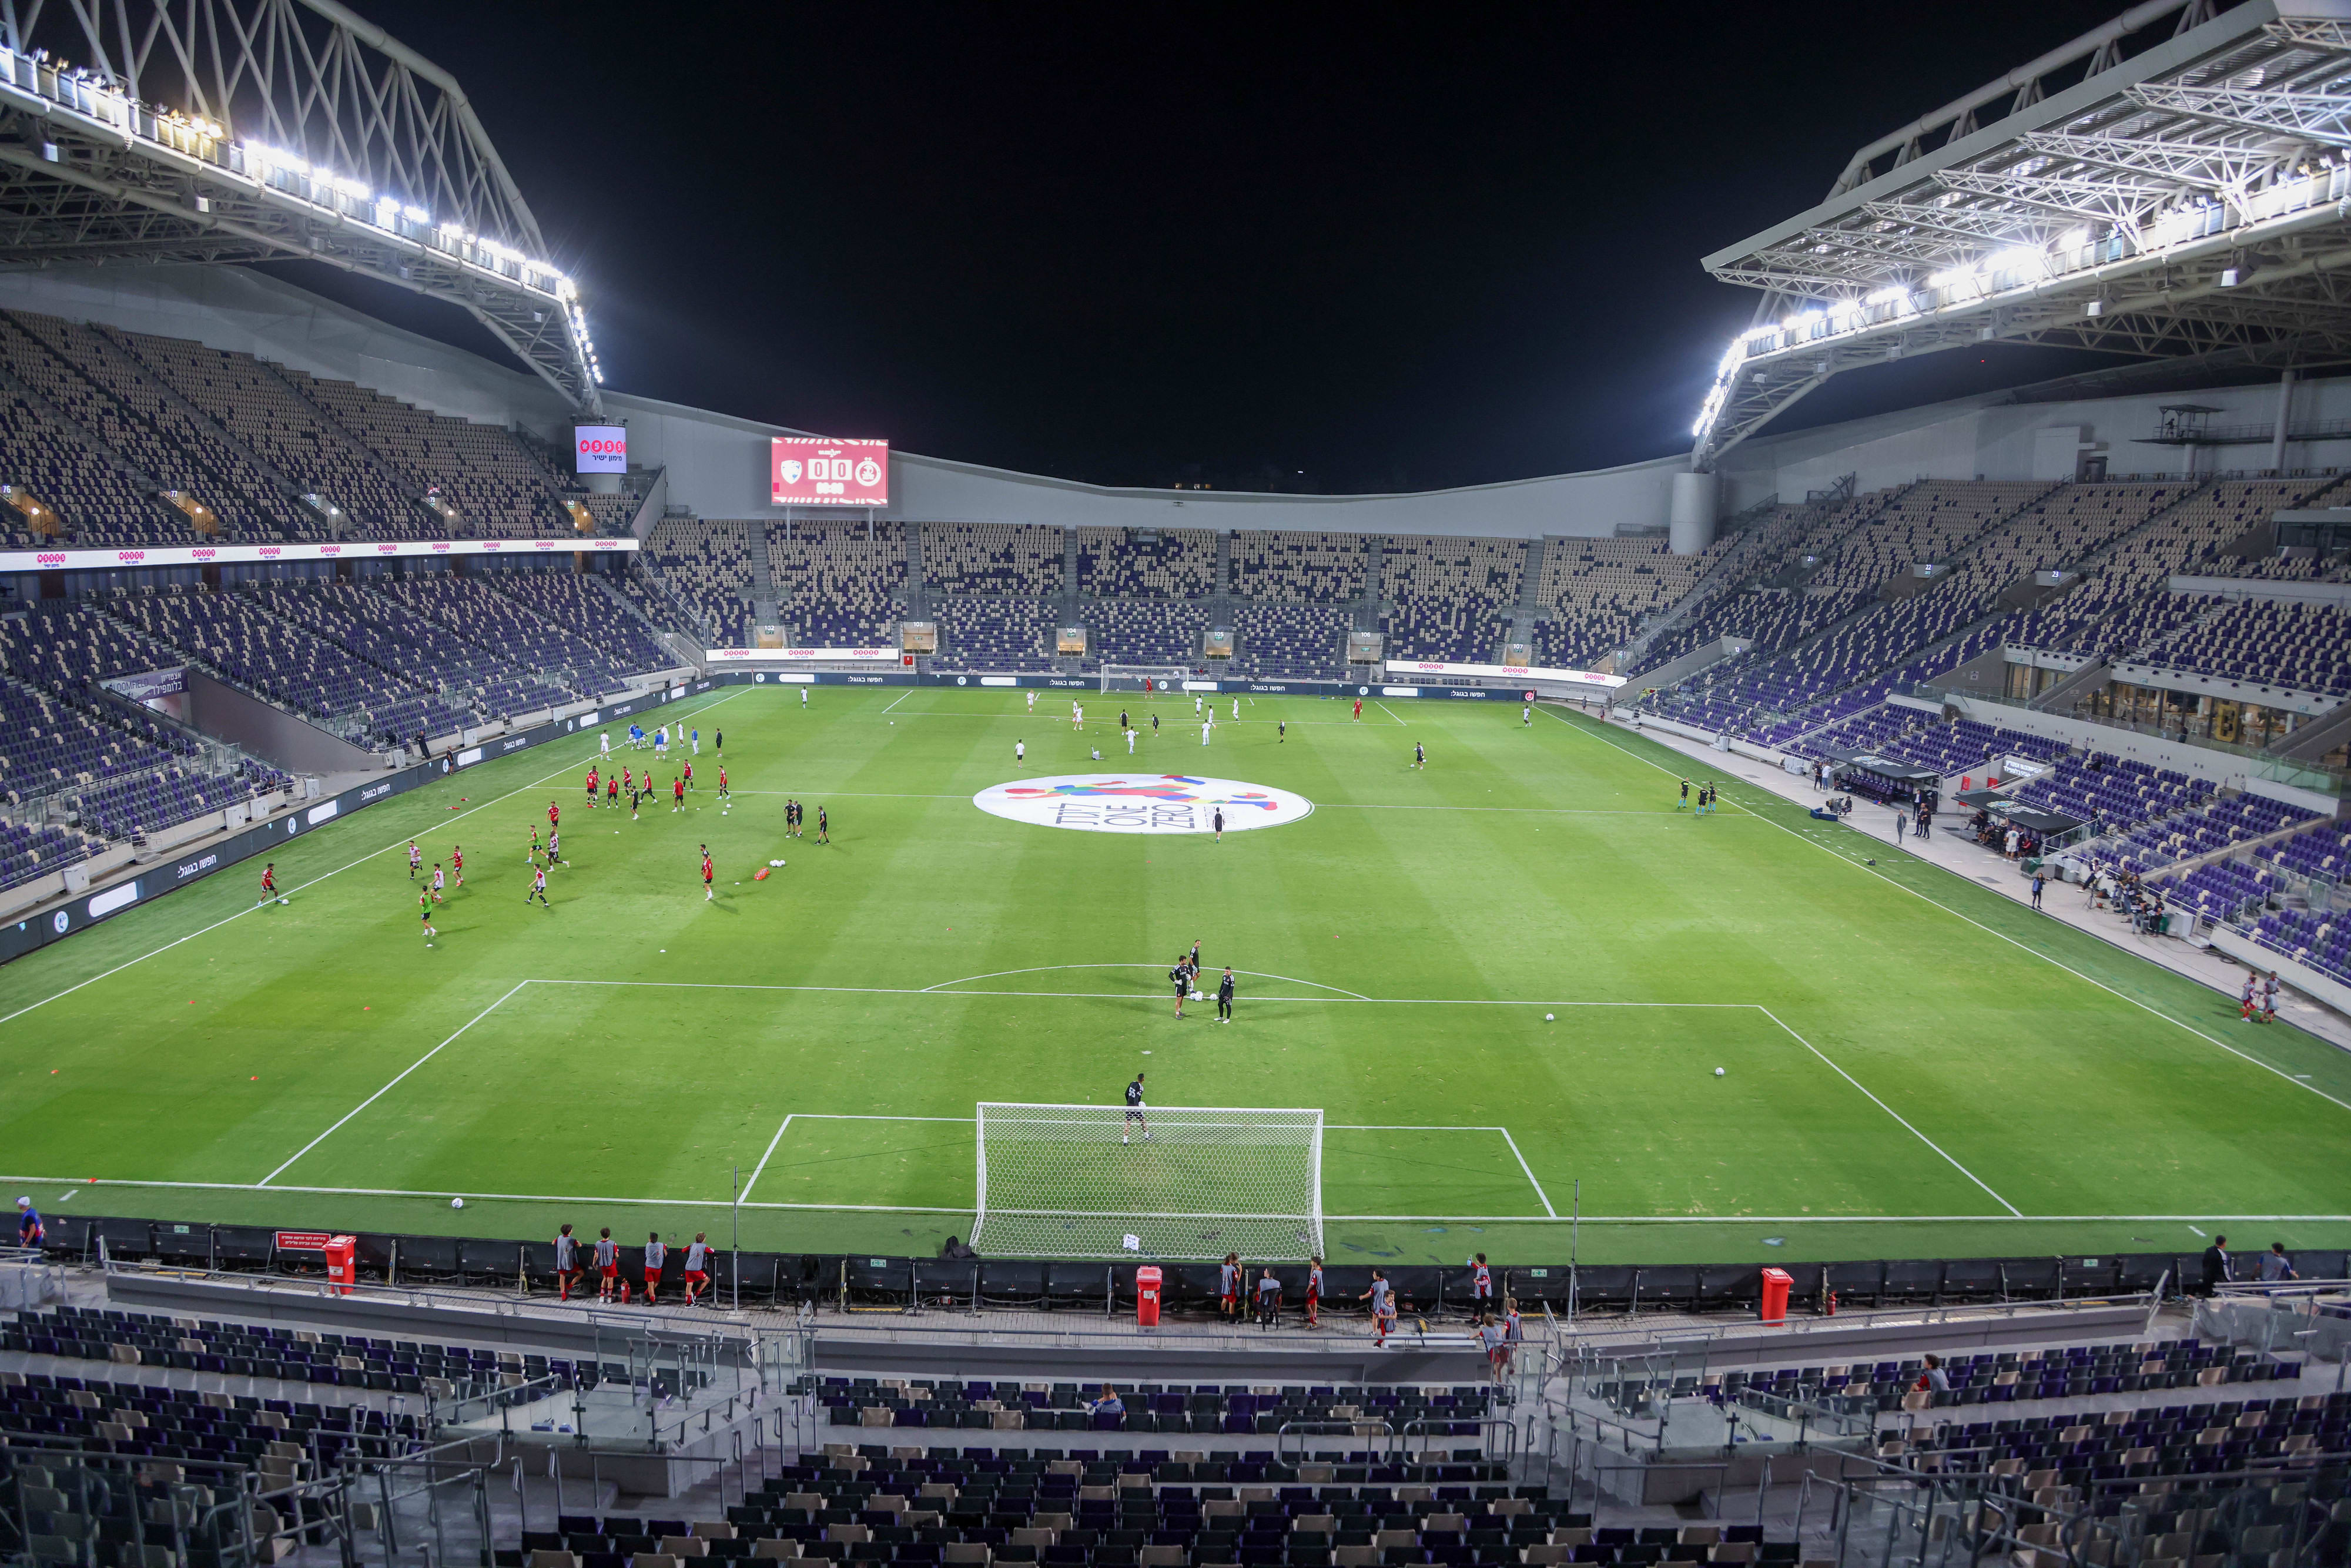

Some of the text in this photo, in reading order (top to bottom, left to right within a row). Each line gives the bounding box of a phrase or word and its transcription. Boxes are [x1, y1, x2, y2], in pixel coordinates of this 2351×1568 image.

[815, 462, 846, 477] 0 0
[153, 681, 182, 695] בלומפילד
[515, 738, 525, 747] חפשו
[361, 783, 390, 801] חפשו בגוגל:
[1047, 803, 1101, 825] ליגת
[1103, 805, 1147, 826] ONE
[1151, 804, 1195, 829] ZERO
[178, 855, 216, 879] חפשו בגוגל:
[1128, 1087, 1136, 1098] 55
